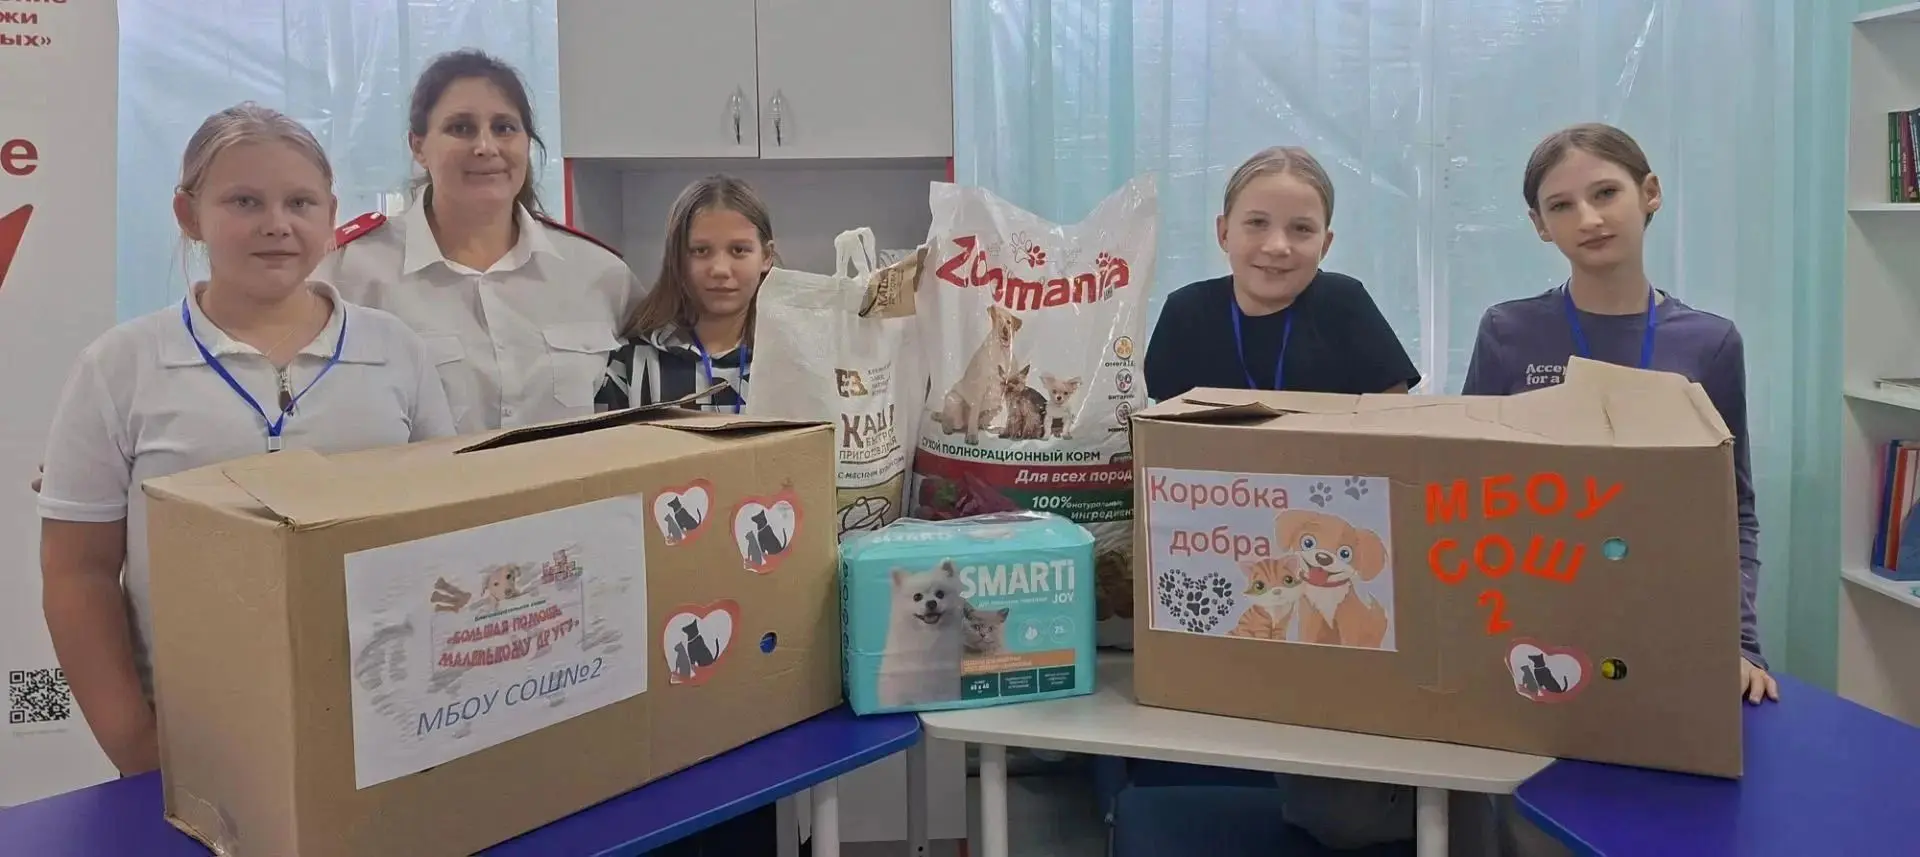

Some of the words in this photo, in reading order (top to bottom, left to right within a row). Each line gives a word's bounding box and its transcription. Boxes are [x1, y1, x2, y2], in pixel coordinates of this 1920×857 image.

[935, 234, 1130, 311] Zoomania
[1526, 374, 1549, 385] for
[1550, 375, 1561, 384] a
[942, 443, 1063, 463] ПОЛНОРАЦИОННЫЙ
[1066, 451, 1101, 462] КОРМ
[1015, 469, 1049, 484] Для
[1052, 471, 1087, 483] всех
[1089, 469, 1133, 484] пород
[1150, 475, 1289, 510] Коробка
[1032, 496, 1072, 509] 100%
[1425, 471, 1625, 526] МБОУ
[1169, 526, 1271, 561] добра
[1427, 533, 1588, 585] СОШ
[1052, 592, 1074, 604] JOY
[1477, 588, 1515, 635] 2
[416, 689, 499, 736] МБОУ
[504, 657, 603, 707] СОШ№2
